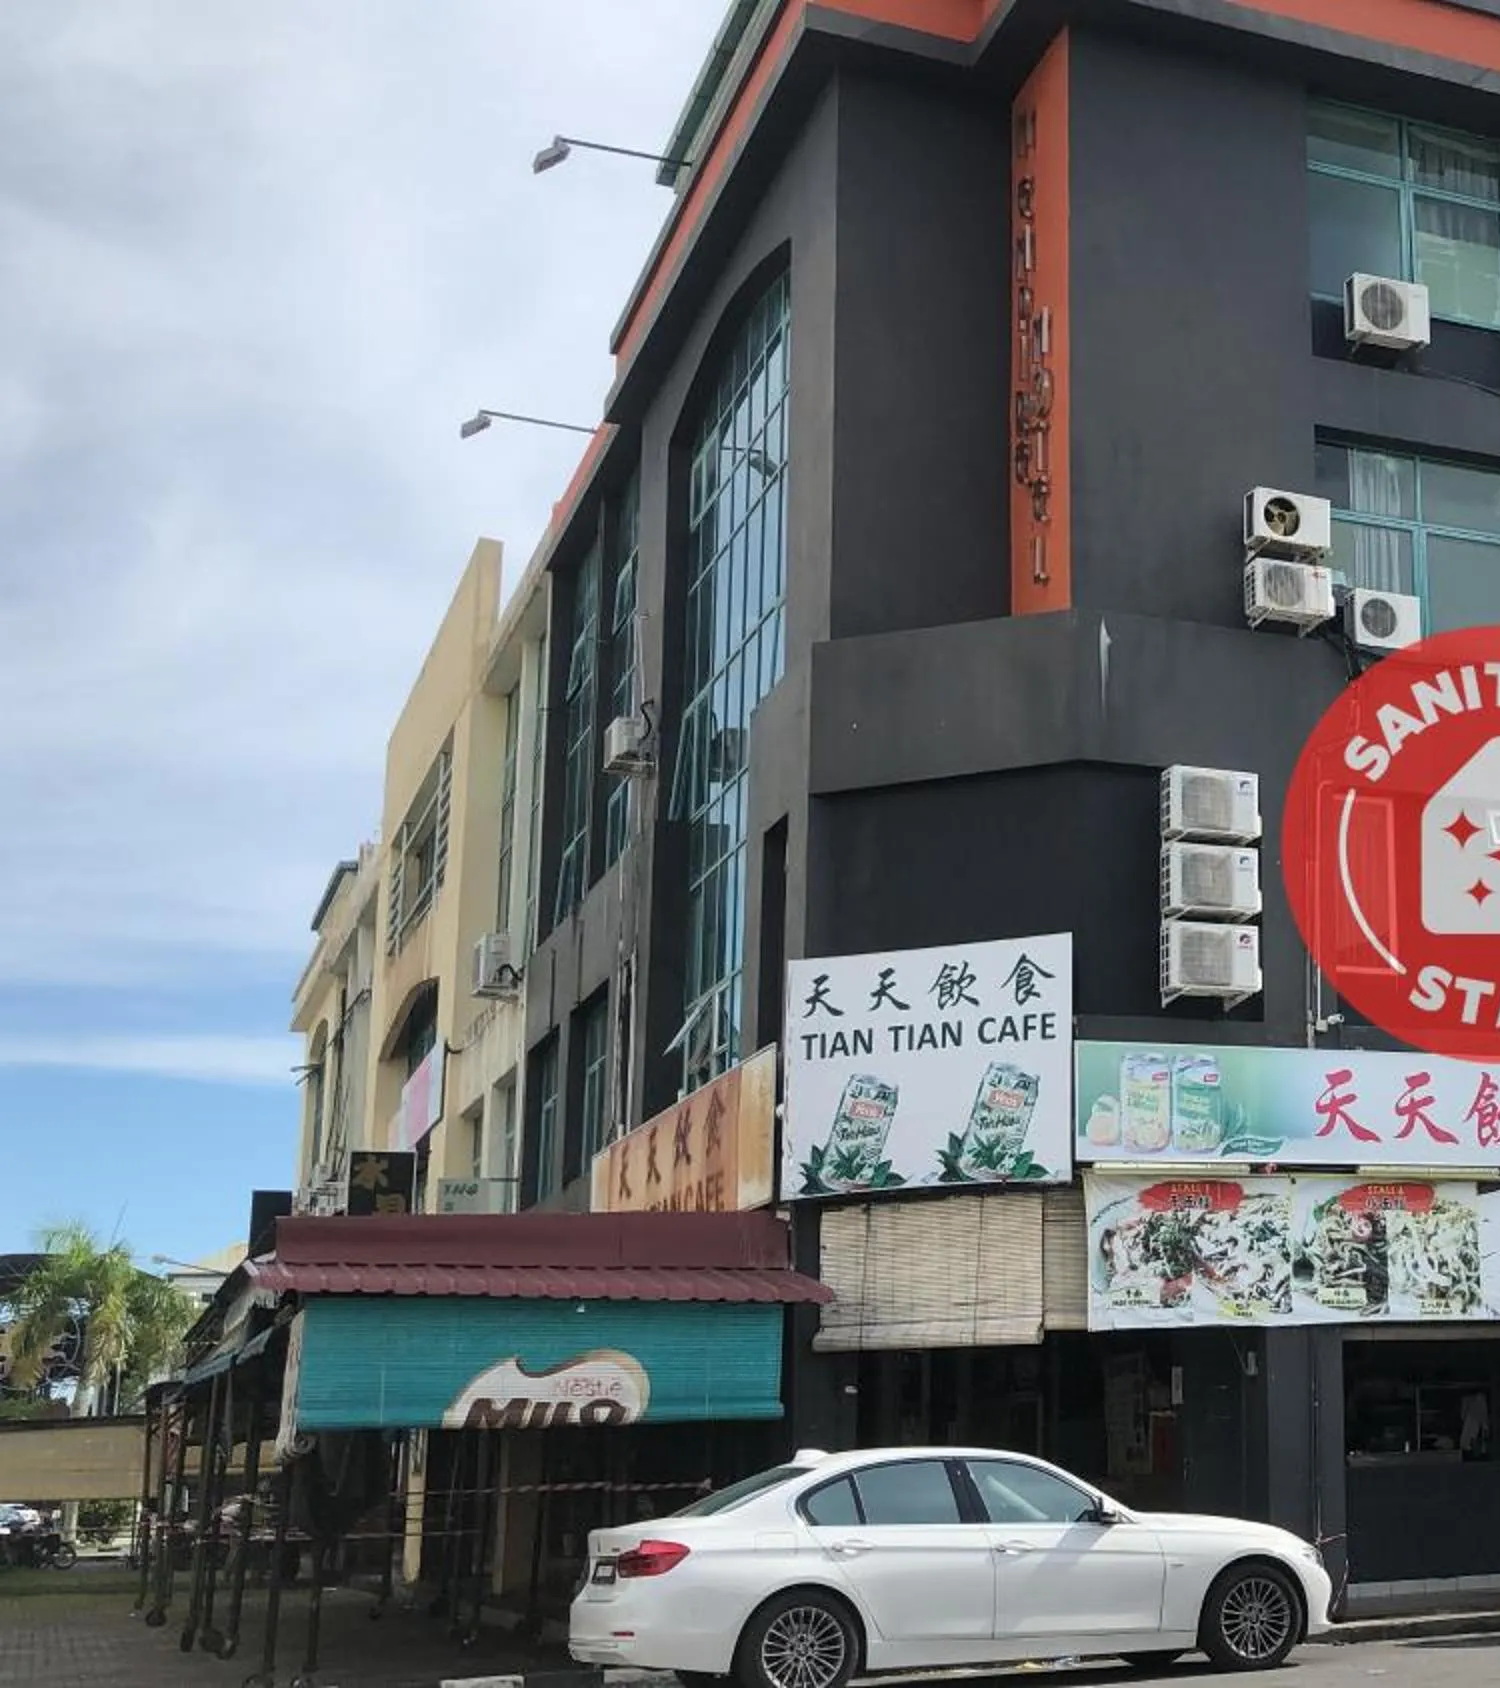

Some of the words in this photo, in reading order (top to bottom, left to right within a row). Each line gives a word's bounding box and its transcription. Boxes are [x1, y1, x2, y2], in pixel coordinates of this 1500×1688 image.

[801, 953, 1057, 1019] 天天飲食
[801, 1028, 874, 1061] TIAN
[888, 1020, 963, 1054] TIAN
[977, 1011, 1057, 1045] CAFE
